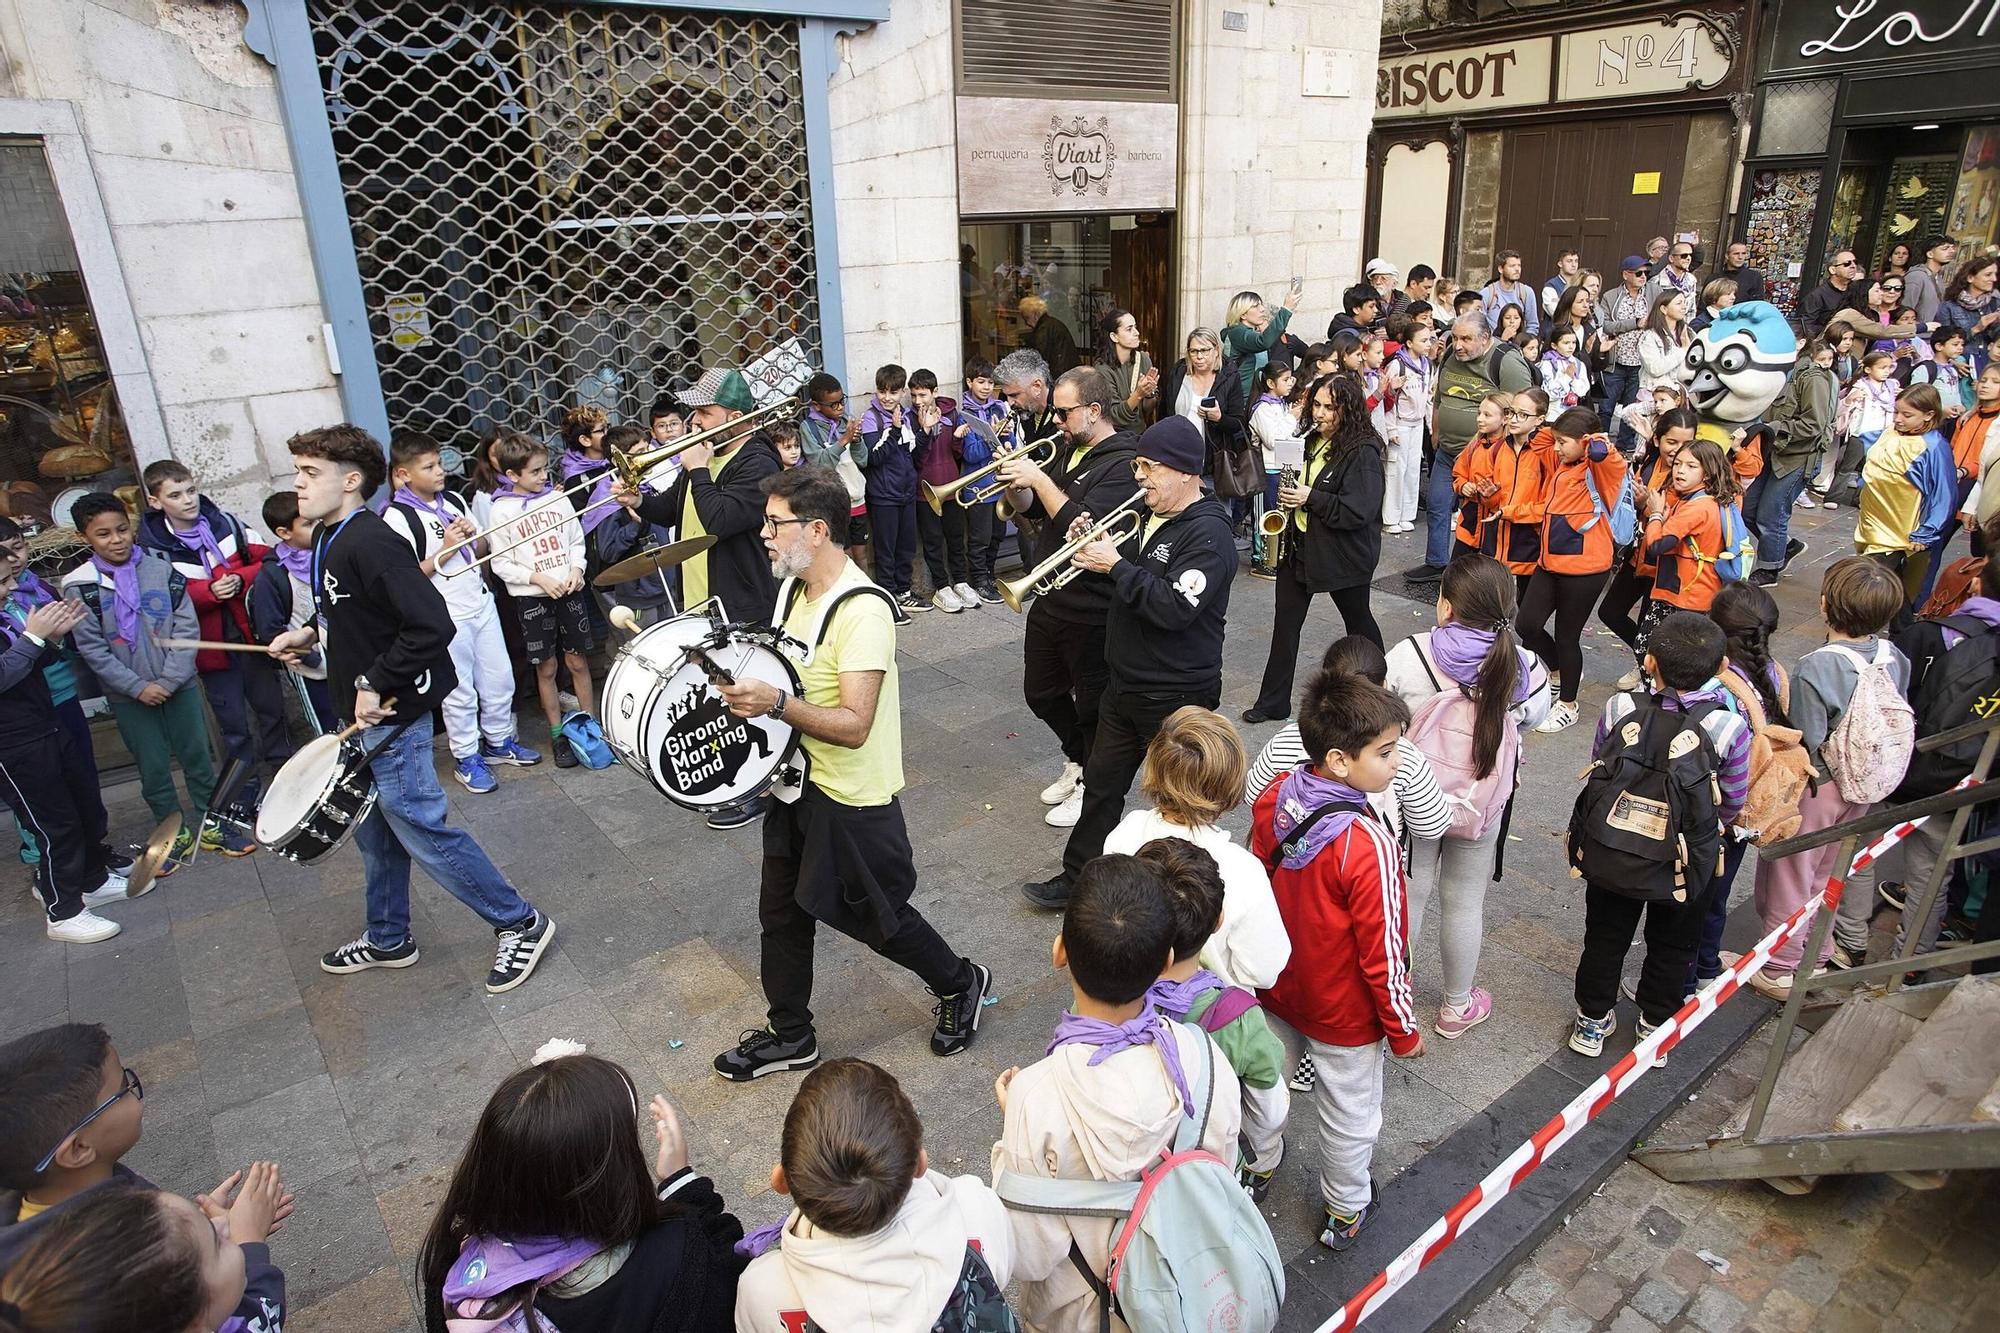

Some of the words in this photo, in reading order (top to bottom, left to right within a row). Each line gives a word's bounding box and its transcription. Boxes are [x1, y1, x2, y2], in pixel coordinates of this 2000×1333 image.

[1660, 26, 1700, 79] 4
[971, 148, 1029, 163] perruqueria
[1057, 142, 1102, 164] Viart
[532, 535, 561, 557] 198
[665, 714, 729, 756] Girona
[670, 724, 748, 775] Marxing
[676, 752, 725, 792] Band
